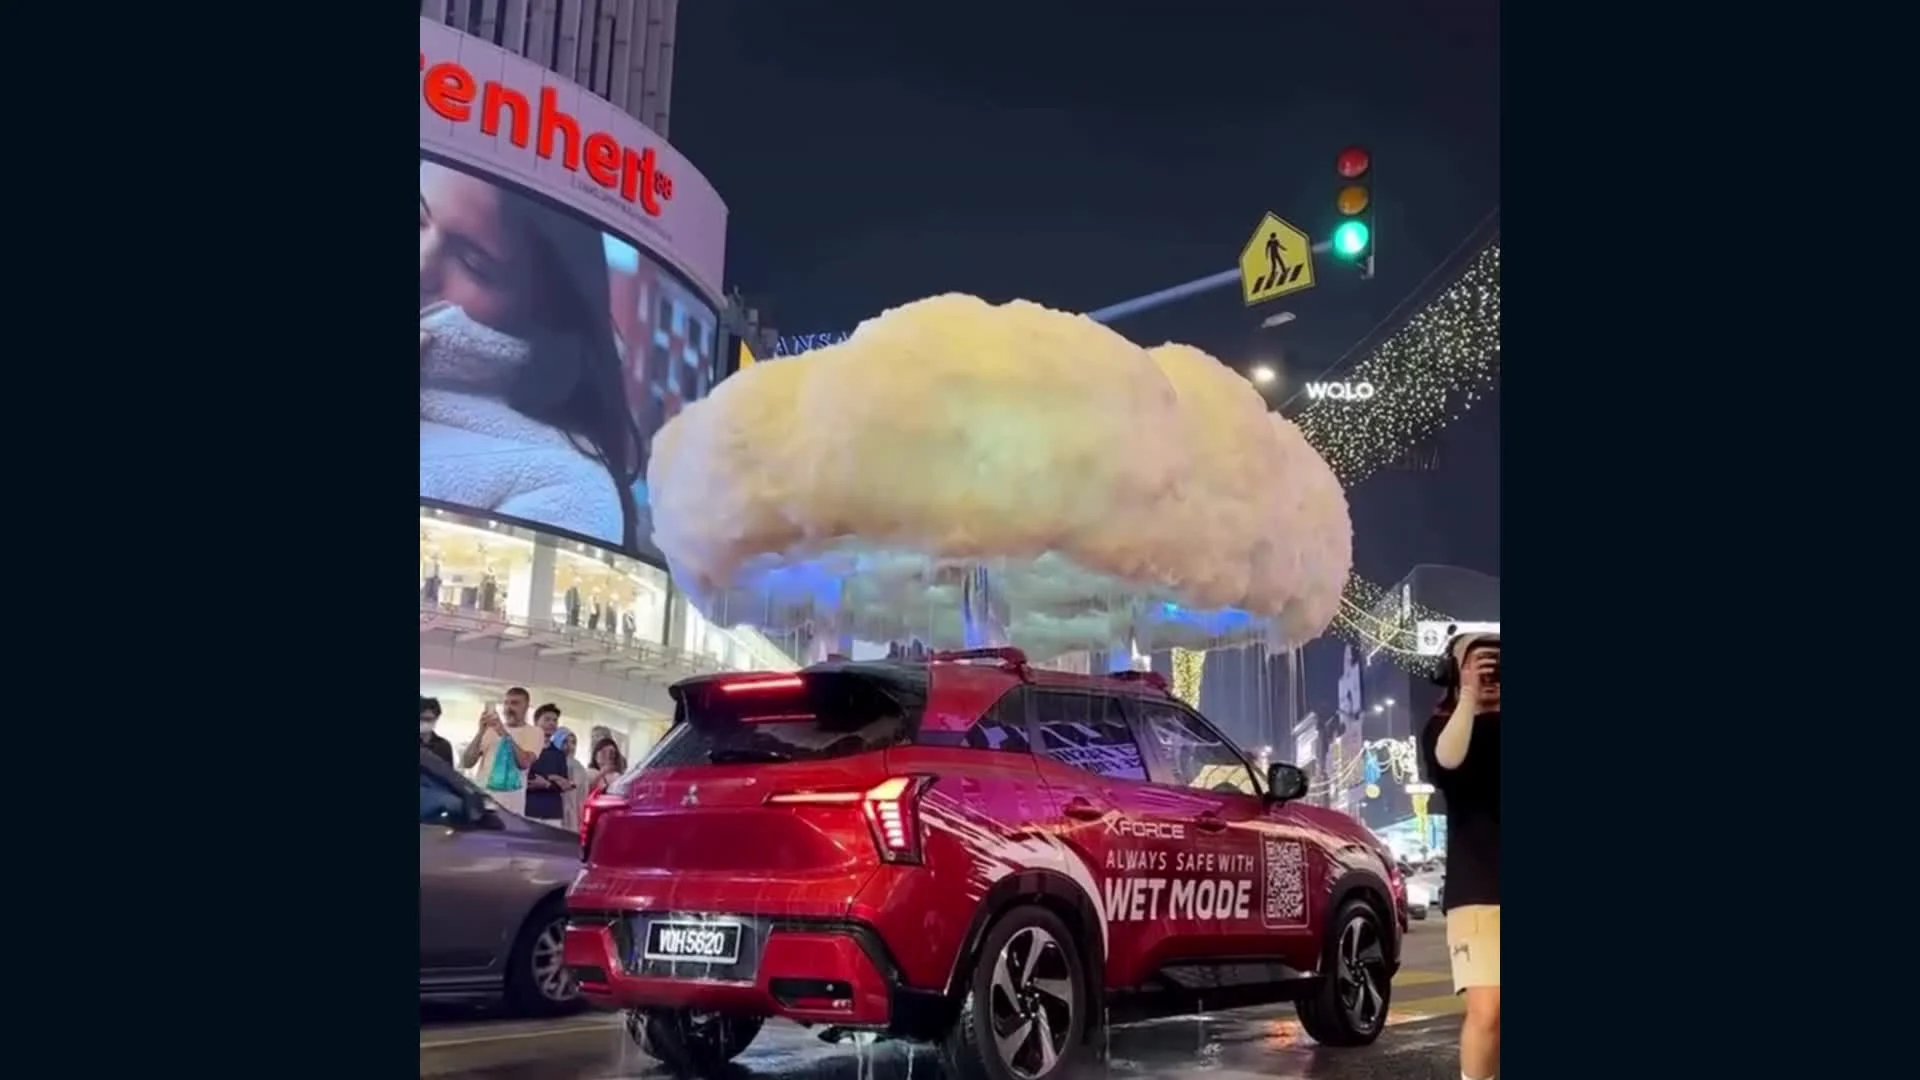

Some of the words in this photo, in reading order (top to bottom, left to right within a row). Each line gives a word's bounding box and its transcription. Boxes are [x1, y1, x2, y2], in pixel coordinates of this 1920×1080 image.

[1305, 381, 1374, 400] WOLO
[1104, 814, 1184, 839] XFORCE
[1105, 849, 1167, 871] ALWAYS
[1175, 852, 1215, 872] SAFE
[1218, 854, 1255, 873] WITH
[1105, 877, 1167, 922] WET
[1169, 879, 1252, 921] MODE
